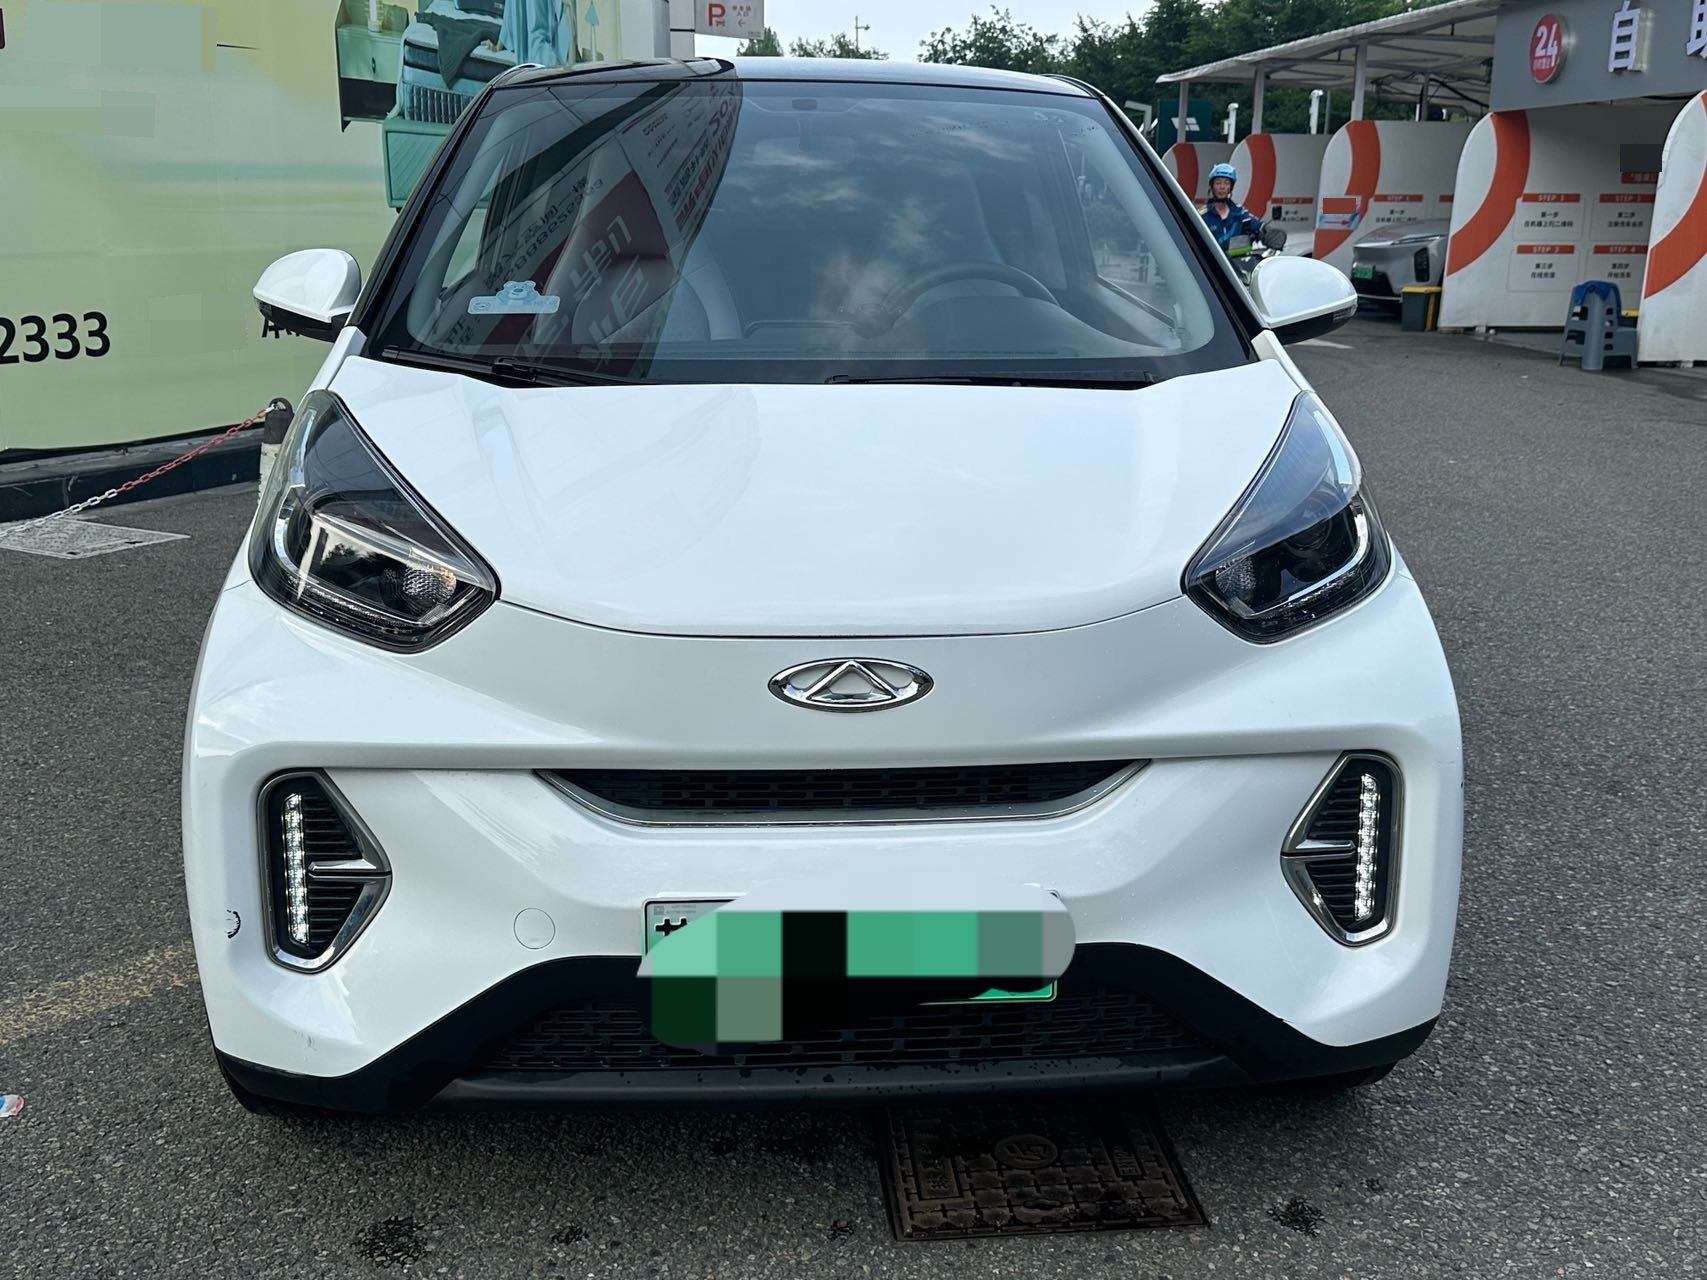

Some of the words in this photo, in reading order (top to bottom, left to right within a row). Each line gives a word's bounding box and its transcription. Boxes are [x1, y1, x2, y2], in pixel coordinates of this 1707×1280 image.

[708, 3, 726, 27] P
[1534, 23, 1558, 67] 24
[0, 311, 111, 364] 2333
